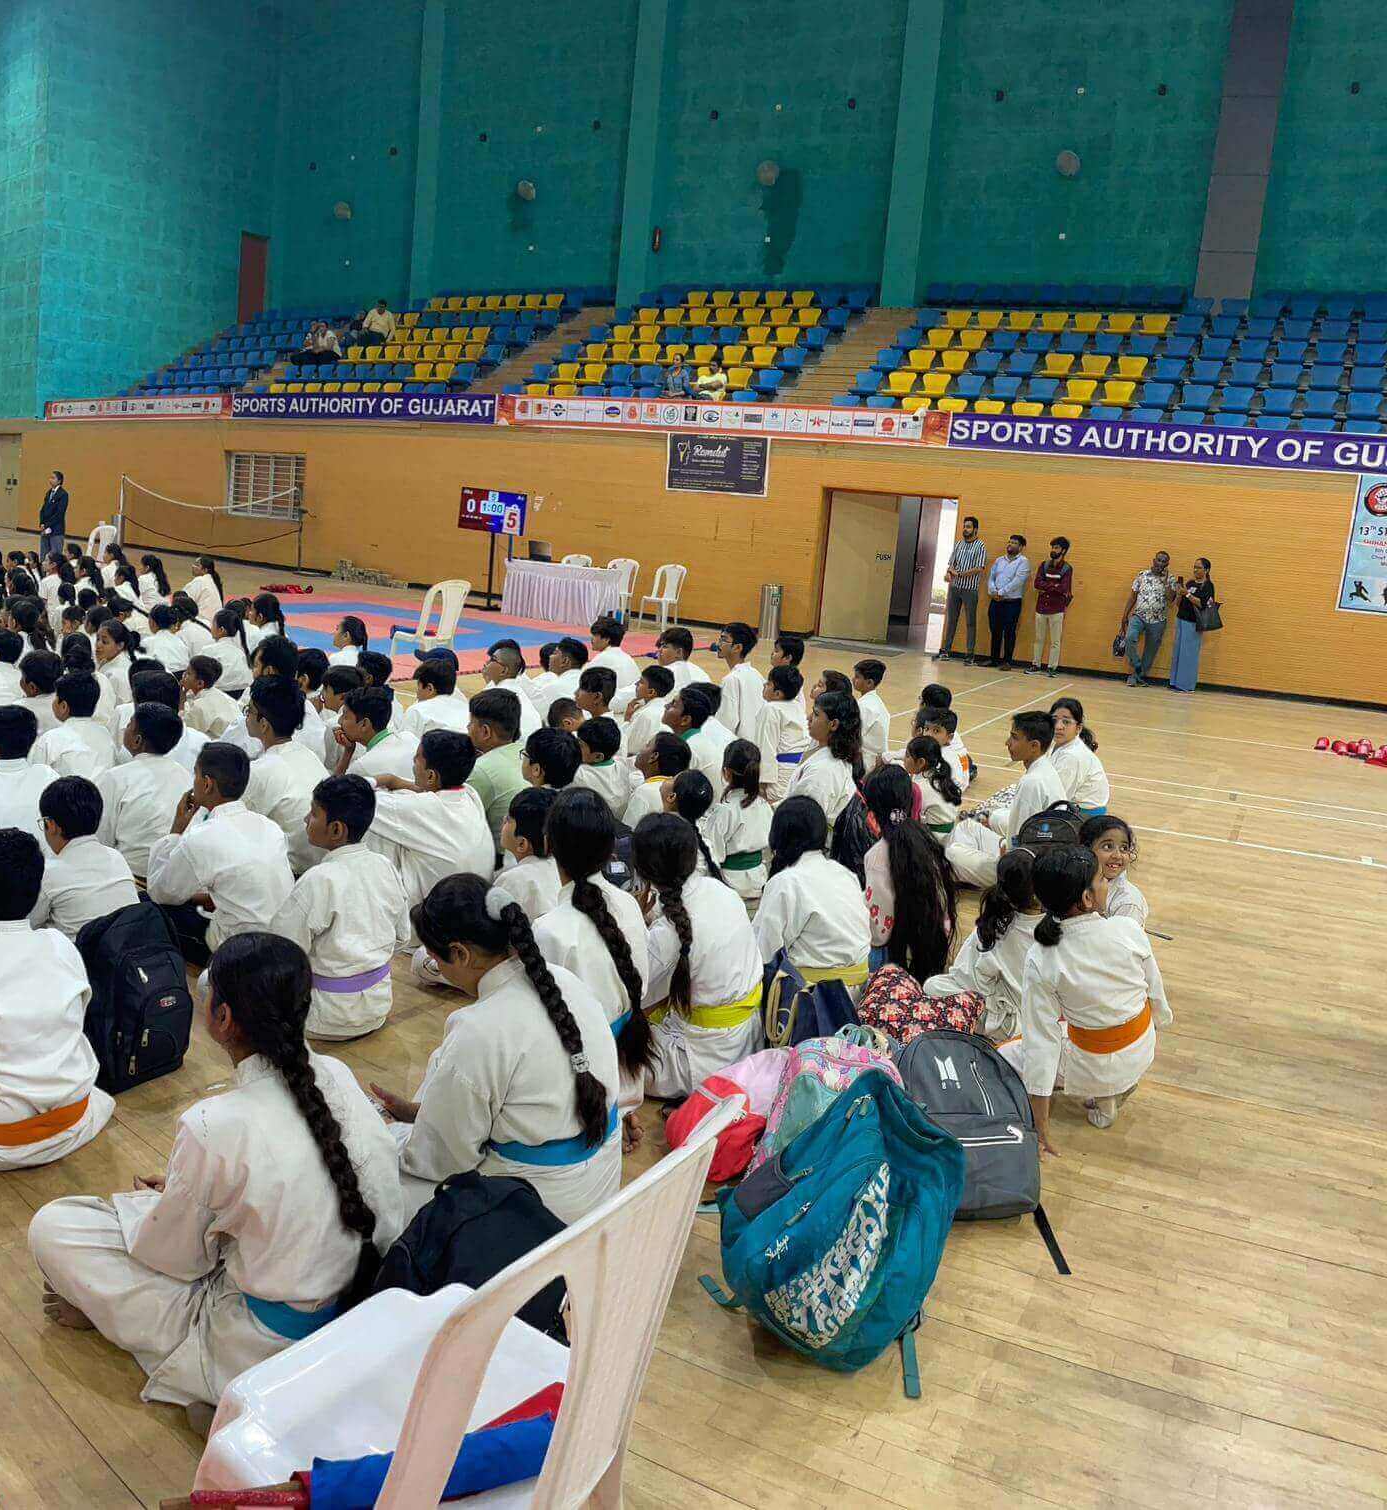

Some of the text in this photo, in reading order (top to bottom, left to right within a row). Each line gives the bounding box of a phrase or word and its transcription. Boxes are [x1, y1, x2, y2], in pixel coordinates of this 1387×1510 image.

[233, 398, 494, 417] SPORTS AUTHORITY OF GUJARAT
[952, 419, 1387, 469] SPORTS AUTHORITY OF GU
[467, 498, 504, 514] 0 1:00
[507, 512, 518, 529] 5
[875, 553, 892, 561] PUSH
